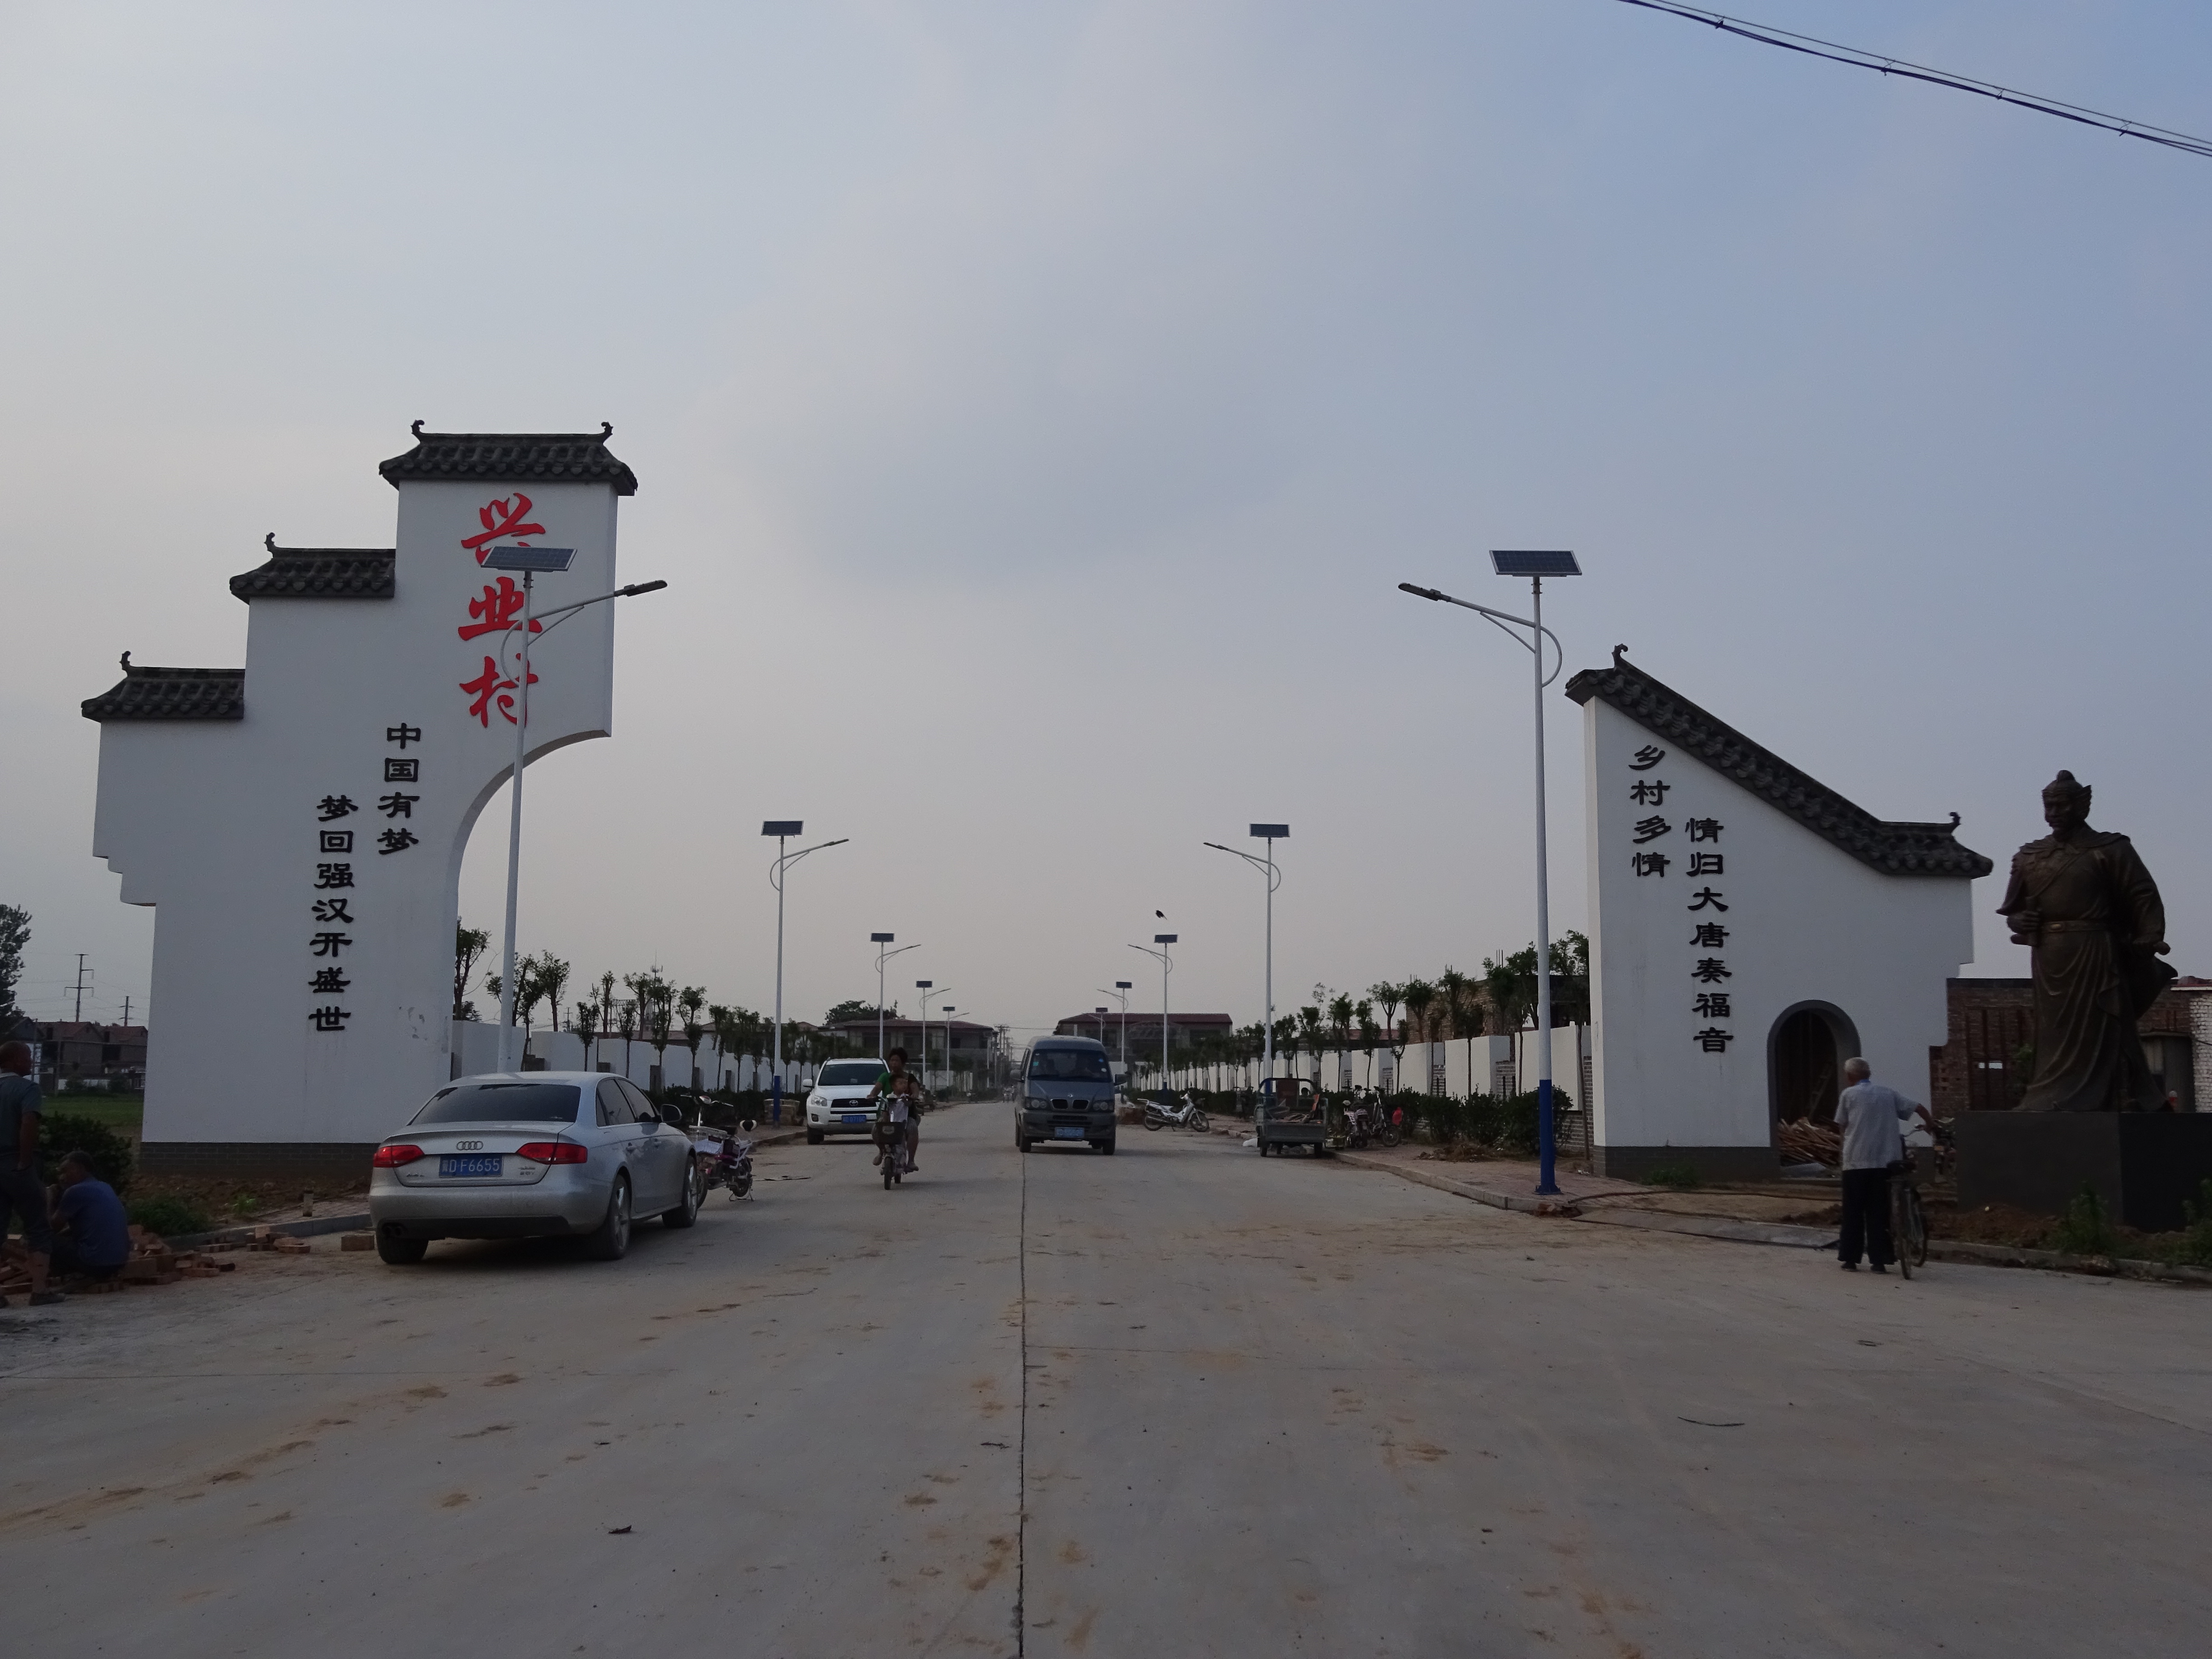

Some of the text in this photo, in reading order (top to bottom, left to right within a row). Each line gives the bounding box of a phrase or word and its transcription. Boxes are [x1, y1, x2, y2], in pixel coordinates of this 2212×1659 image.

[458, 492, 546, 728] 兴业村
[377, 722, 421, 855] 中国有梦
[1628, 745, 1672, 877] 乡村多情
[308, 794, 359, 1031] 梦回强汉开盛世
[1685, 817, 1734, 1053] 情归大唐奏福音
